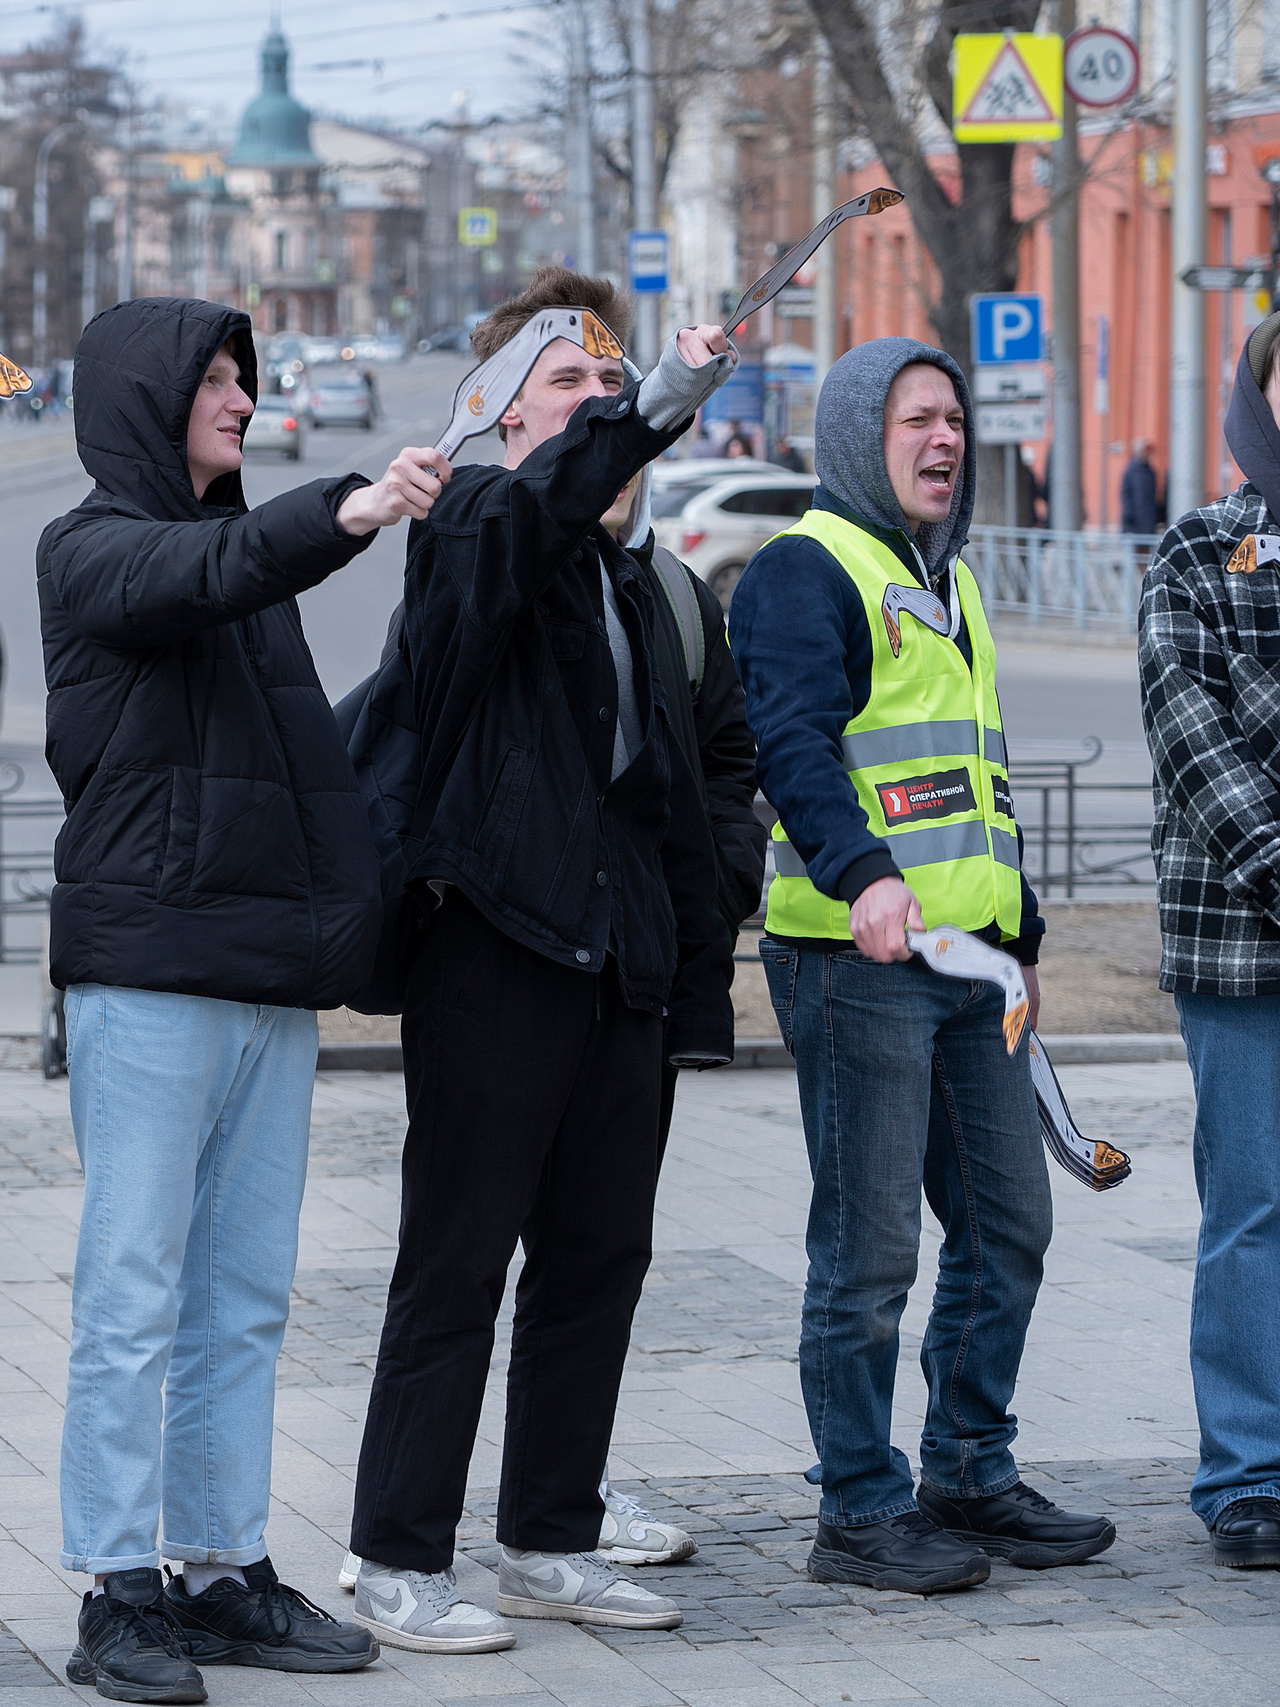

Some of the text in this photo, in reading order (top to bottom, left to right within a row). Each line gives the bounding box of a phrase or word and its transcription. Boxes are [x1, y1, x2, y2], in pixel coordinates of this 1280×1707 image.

[1079, 48, 1124, 82] 40
[992, 302, 1033, 360] P
[906, 782, 934, 794] ЦЕНТР
[909, 783, 966, 802] ОПЕРАТИВНОЙ
[911, 798, 944, 811] ПЕЧАТИ
[125, 1573, 148, 1581] adidas
